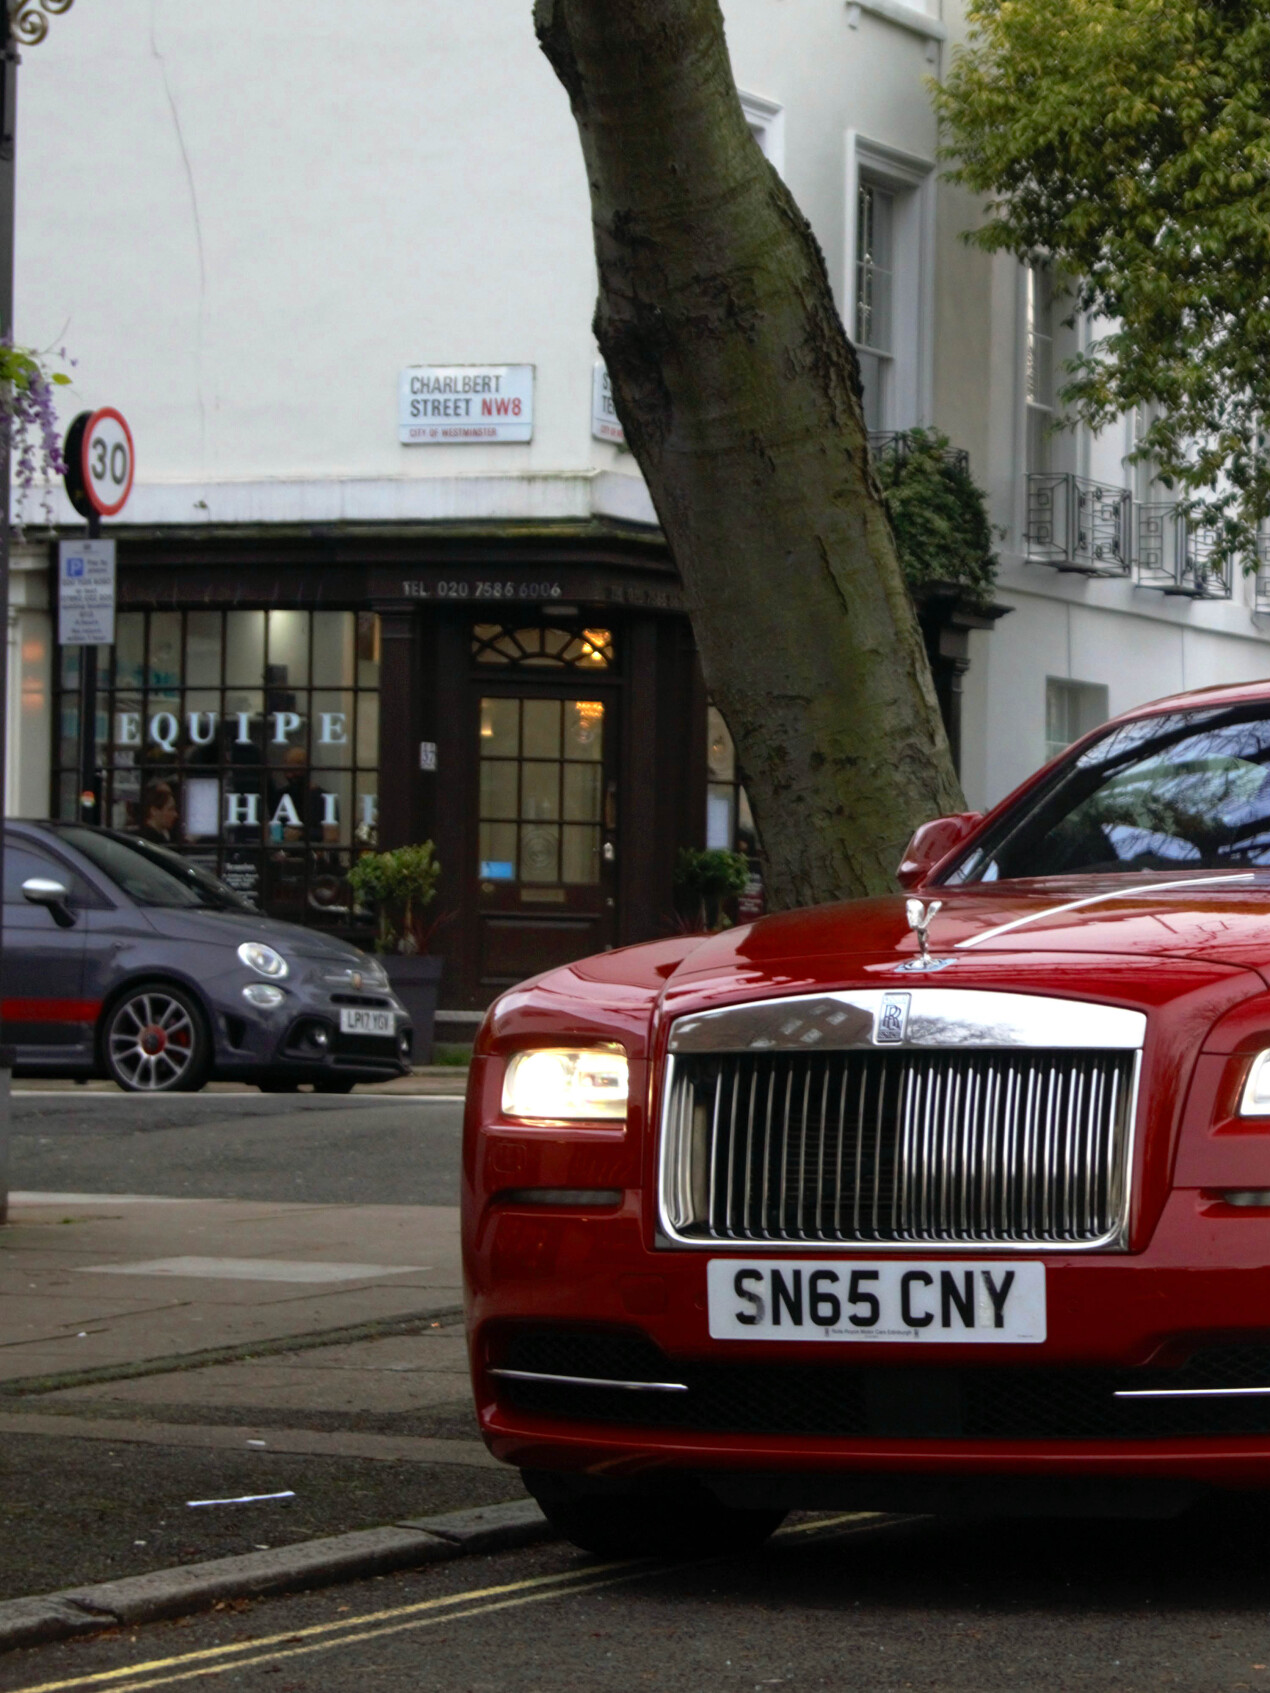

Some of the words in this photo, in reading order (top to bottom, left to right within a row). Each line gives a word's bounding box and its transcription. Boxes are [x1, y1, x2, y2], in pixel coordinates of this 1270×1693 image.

[410, 375, 502, 394] CHARLBERT
[410, 398, 472, 417] STREET
[481, 397, 522, 416] NW8
[410, 428, 426, 438] CITY
[429, 428, 438, 438] OF
[441, 427, 497, 438] WESTMINSTER
[91, 437, 127, 485] 30
[437, 582, 468, 597] 020
[474, 582, 514, 597] 7586
[518, 582, 561, 597] 6006
[118, 711, 348, 753] EQUIPE
[734, 1268, 881, 1327] SN65
[900, 1270, 1015, 1328] CNY
